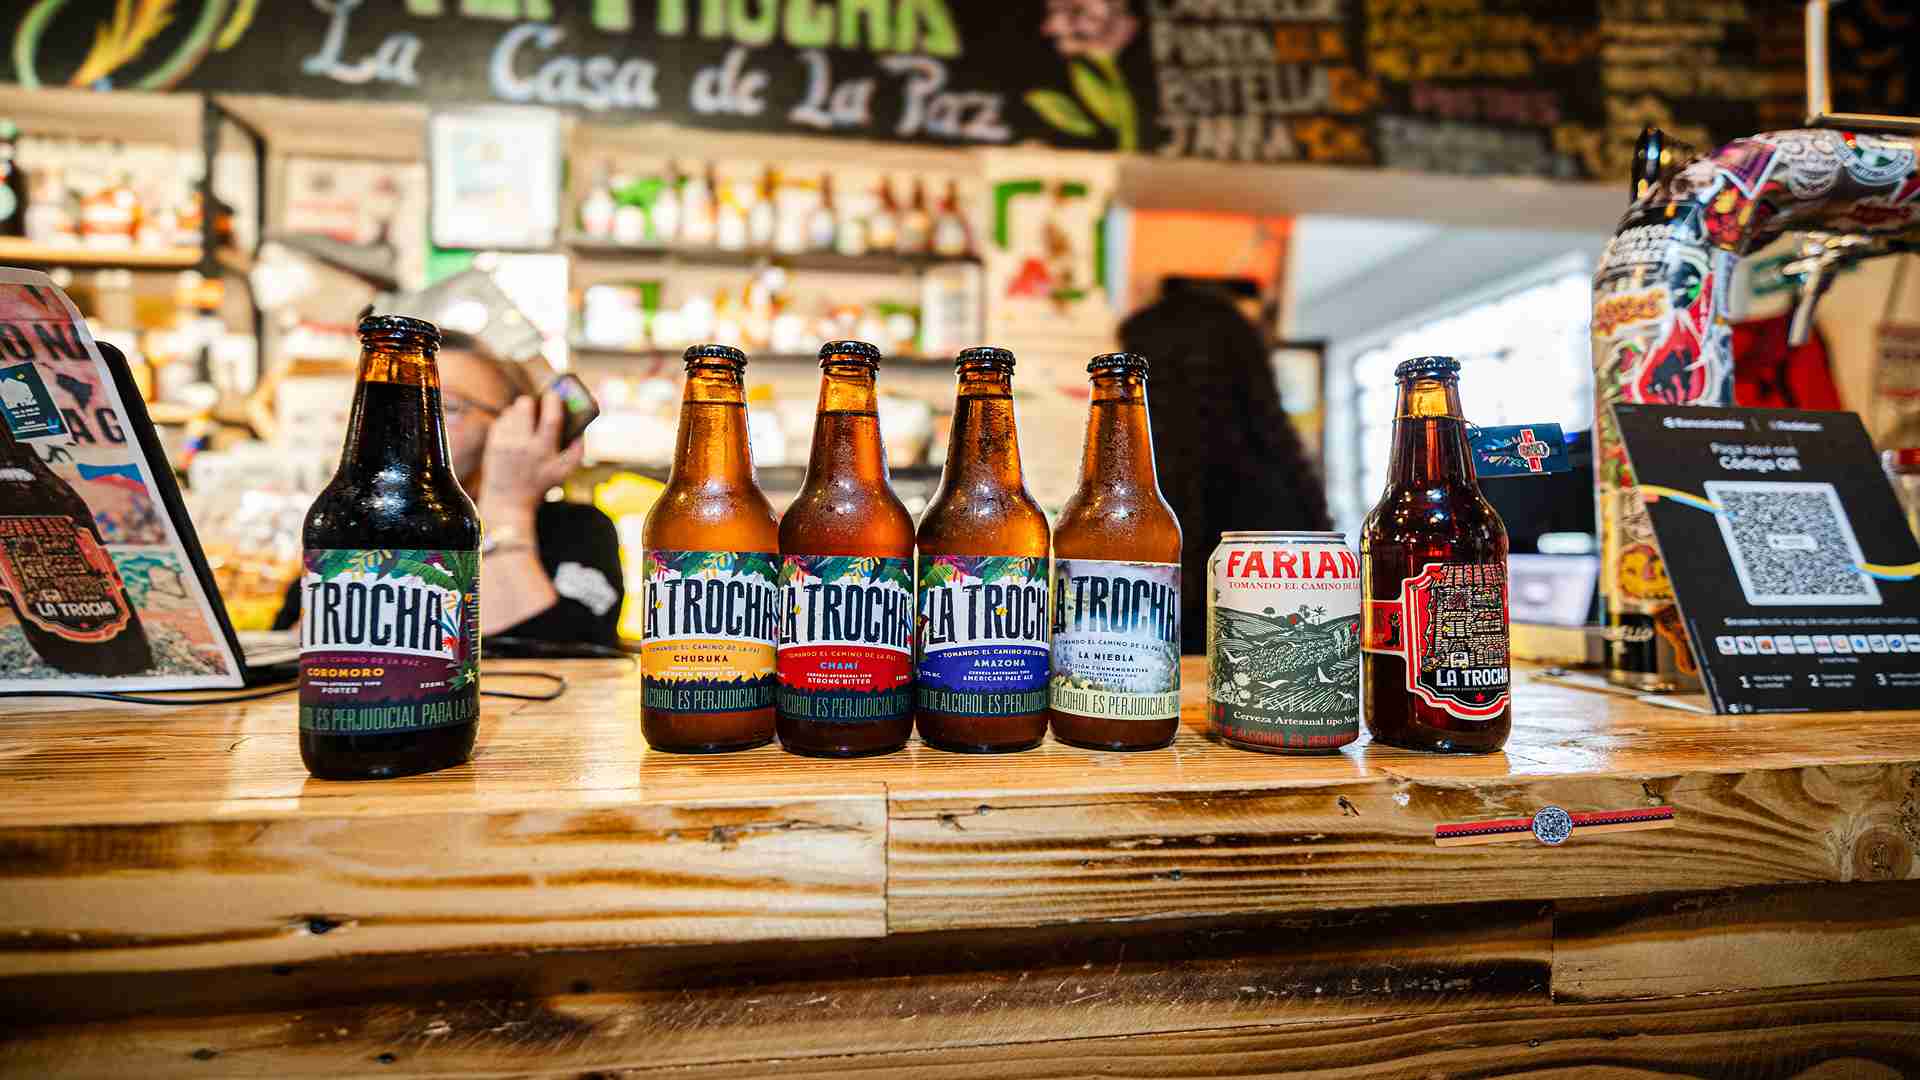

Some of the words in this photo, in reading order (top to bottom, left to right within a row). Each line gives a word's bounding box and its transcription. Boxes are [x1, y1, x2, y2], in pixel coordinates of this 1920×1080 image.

[303, 0, 422, 84] La
[488, 23, 657, 110] Casa
[691, 48, 768, 117] de
[788, 50, 877, 127] La
[880, 55, 1012, 141] Paz
[1227, 551, 1360, 578] FARIAN
[1230, 582, 1281, 590] TOMANDO
[1285, 582, 1298, 590] EL
[1301, 582, 1341, 591] CAMINO
[35, 602, 58, 616] LA
[308, 583, 443, 651] TROCHA
[663, 578, 774, 641] TROCHA
[803, 583, 908, 649] TROCHA
[928, 586, 957, 645] LA
[962, 584, 1047, 643] TROCH
[1071, 575, 1176, 643] TROCHA
[943, 649, 979, 658] TOMANDO
[1099, 640, 1128, 648] CAMINO
[673, 655, 729, 663] CHURUKA
[973, 659, 1026, 668] AMAZONA
[1094, 653, 1134, 662] NIEBLA
[807, 677, 840, 685] STRONG
[1436, 669, 1457, 687] LA
[1461, 667, 1509, 687] TROCHA
[1739, 676, 1750, 688] 1
[1808, 674, 1819, 687] 2
[1876, 673, 1887, 686] 3
[678, 689, 691, 710] ES
[694, 687, 758, 711] PERJUDICIAL
[816, 697, 829, 718] ES
[831, 694, 895, 718] PERJUDICIAL
[940, 692, 985, 714] ALCOHOL
[988, 694, 1001, 714] ES
[1056, 688, 1089, 711] ALCOHOL
[1093, 692, 1105, 713] ES
[1108, 695, 1167, 716] PERJUDICIAL
[331, 704, 417, 731] PERJUDICIAL
[422, 700, 455, 726] PARA
[1233, 711, 1272, 723] Cerveza
[1275, 716, 1324, 726] Artesanal
[1326, 717, 1343, 726] tipo
